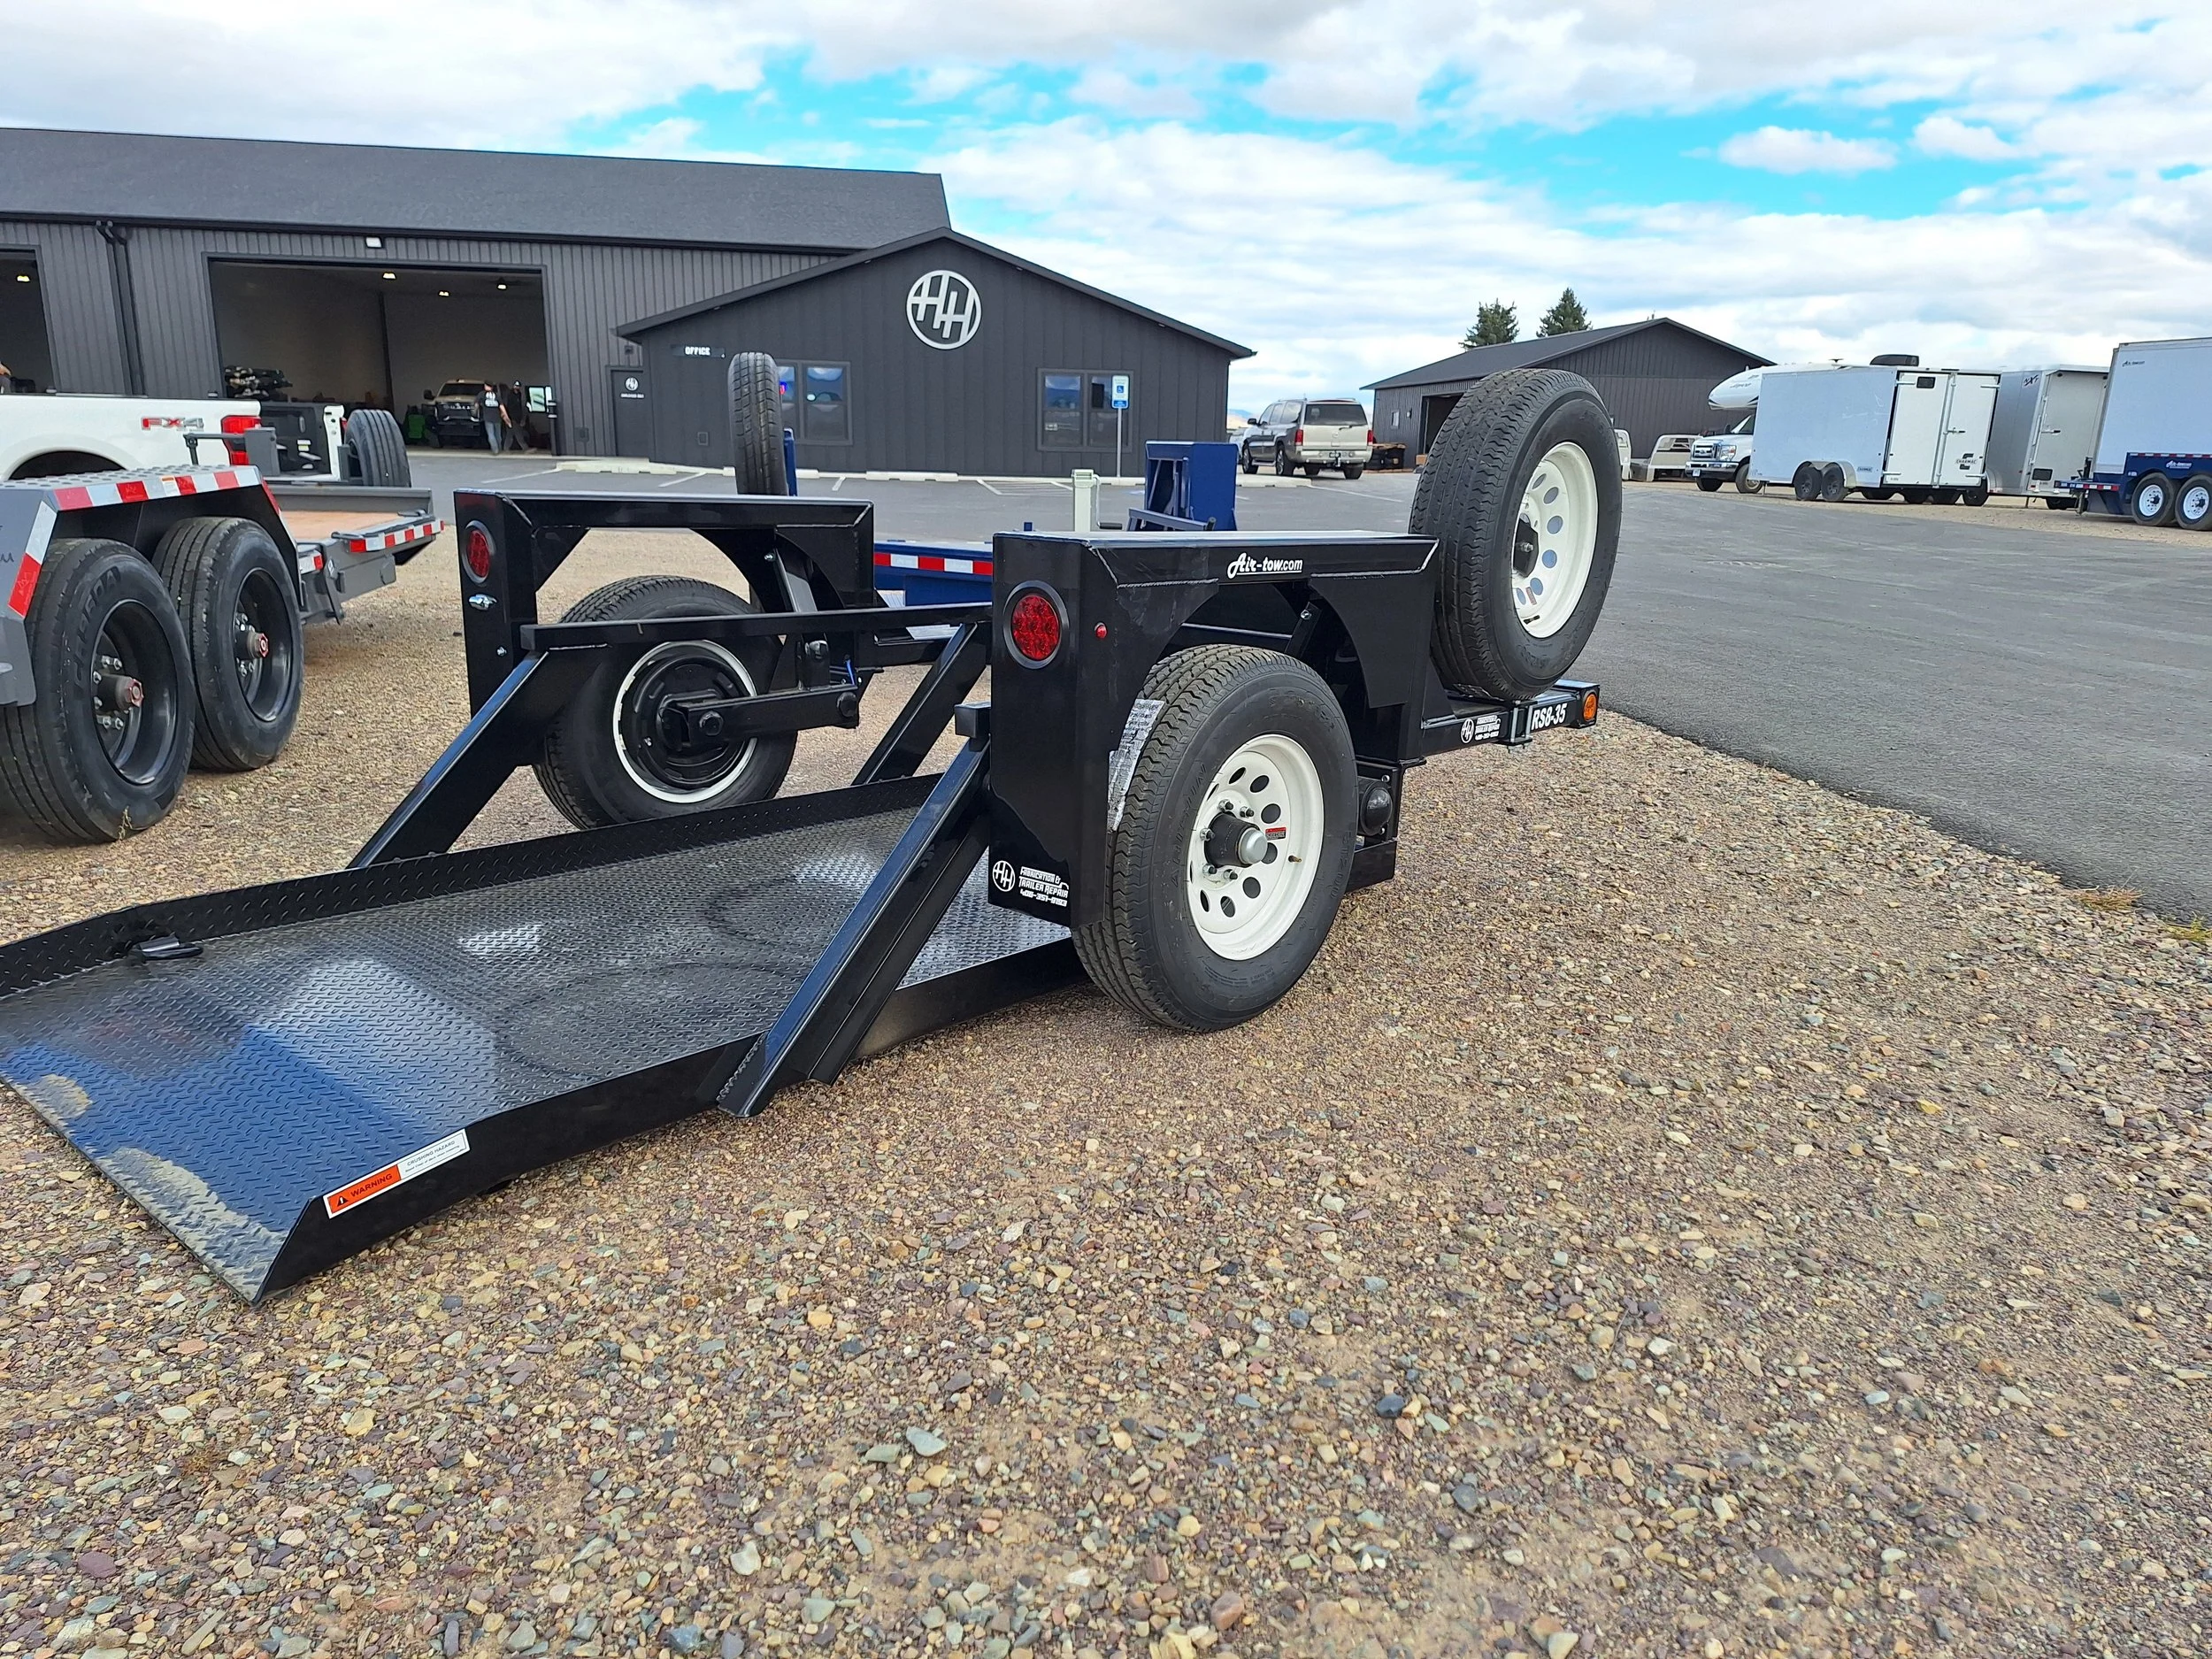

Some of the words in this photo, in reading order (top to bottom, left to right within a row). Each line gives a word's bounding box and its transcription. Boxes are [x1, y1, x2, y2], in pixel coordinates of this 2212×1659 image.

[685, 346, 710, 356] OFFICE
[2024, 374, 2039, 386] NXT
[142, 417, 204, 431] FX4
[1227, 552, 1302, 579] Air-tow.com
[1531, 703, 1567, 730] RS8-35
[407, 1150, 434, 1166] CRUSHING
[434, 1141, 456, 1153] HAZARD
[350, 1173, 393, 1197] WARNING
